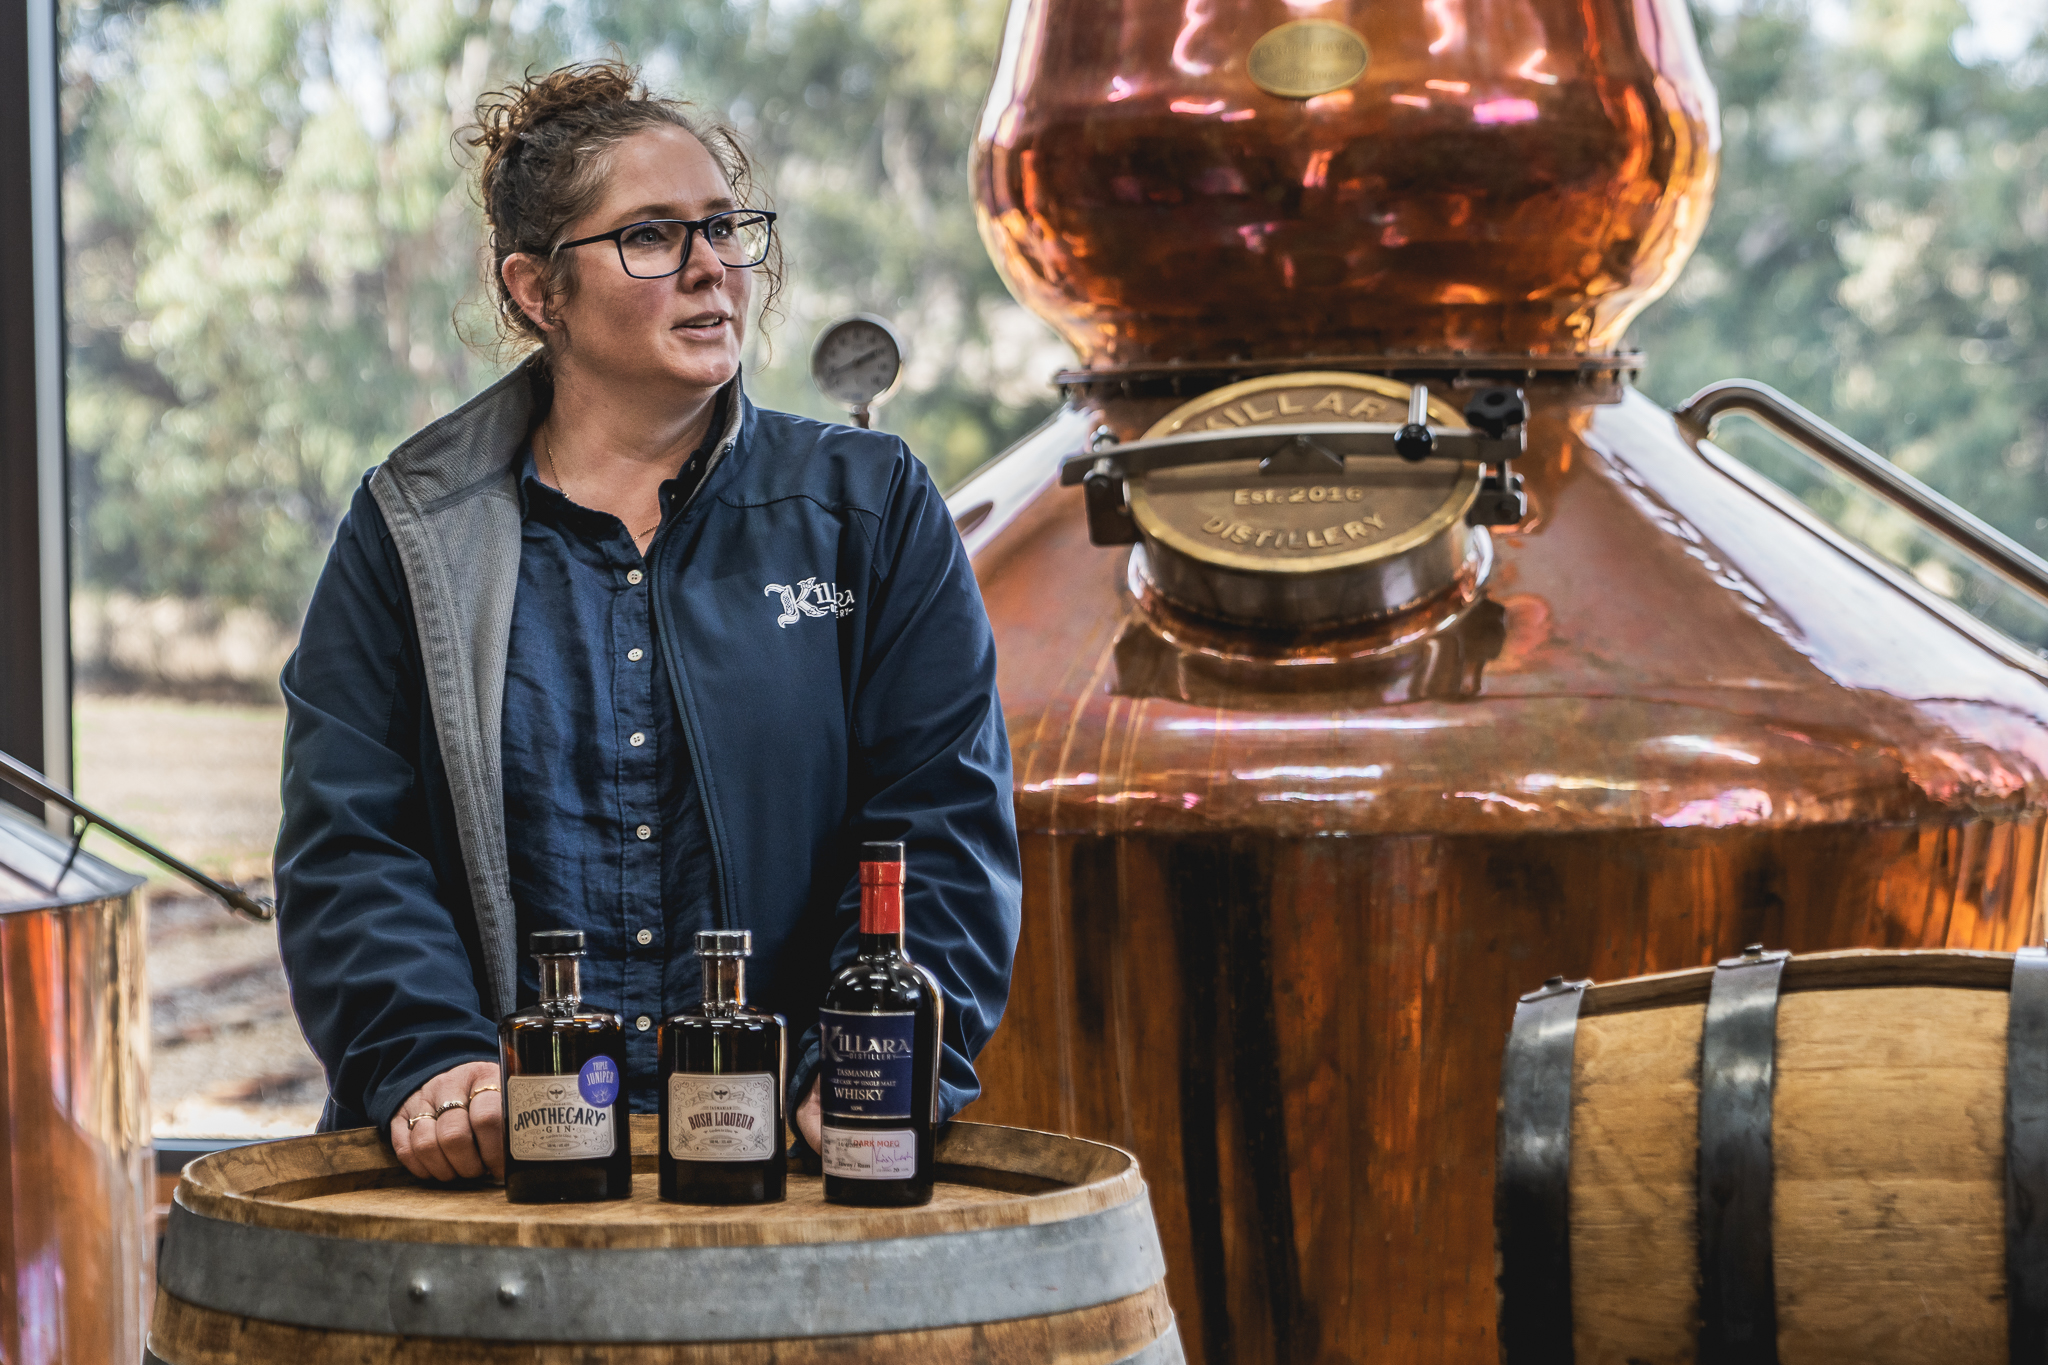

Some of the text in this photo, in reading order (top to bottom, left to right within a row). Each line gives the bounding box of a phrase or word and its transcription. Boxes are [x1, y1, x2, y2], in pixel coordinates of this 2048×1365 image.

[1205, 391, 1390, 430] KILLAR
[1234, 488, 1284, 506] Est.
[1201, 513, 1387, 549] DISTILLERY
[849, 1053, 897, 1061] DISTILLERY
[592, 1061, 608, 1071] TRIPLE
[836, 1068, 881, 1078] TASMANIAN
[586, 1071, 614, 1086] JUNIPER
[834, 1086, 884, 1101] WHISKY
[514, 1107, 606, 1132] APOTHECARY
[688, 1111, 755, 1130] BUSH LIQUEUR
[545, 1125, 571, 1133] GIN
[854, 1140, 875, 1148] DARK
[876, 1140, 900, 1148] MOFO
